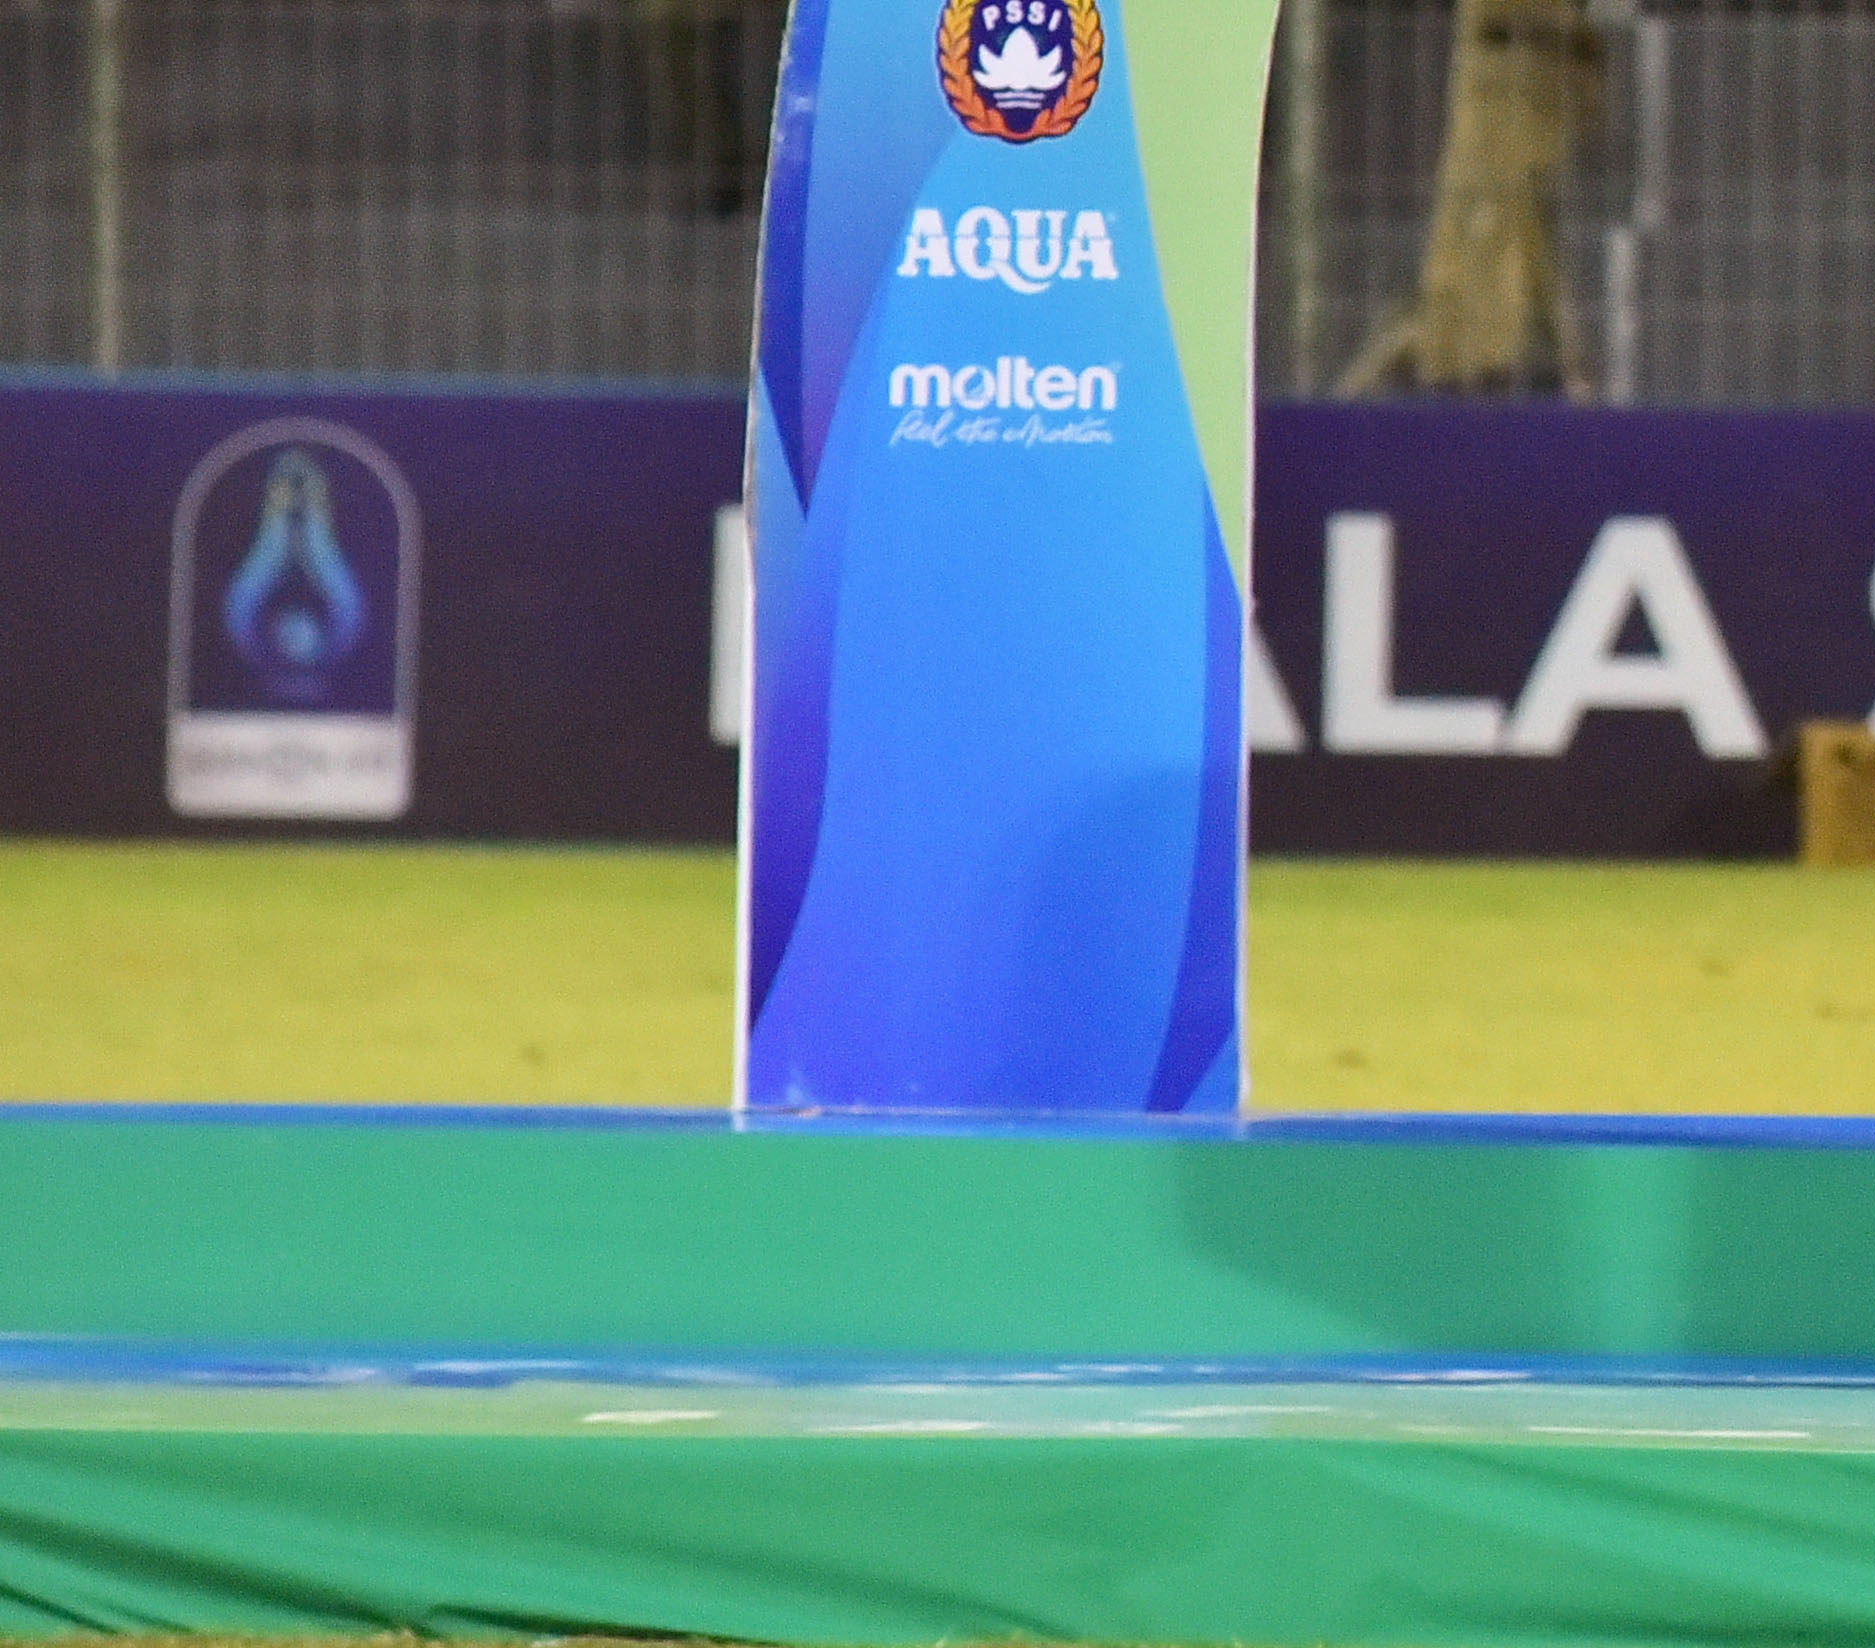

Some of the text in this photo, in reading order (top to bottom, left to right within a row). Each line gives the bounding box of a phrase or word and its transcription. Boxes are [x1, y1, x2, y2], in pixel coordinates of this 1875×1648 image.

[982, 0, 1062, 31] PSSI
[897, 207, 1118, 294] AQUA
[889, 356, 1117, 411] molten
